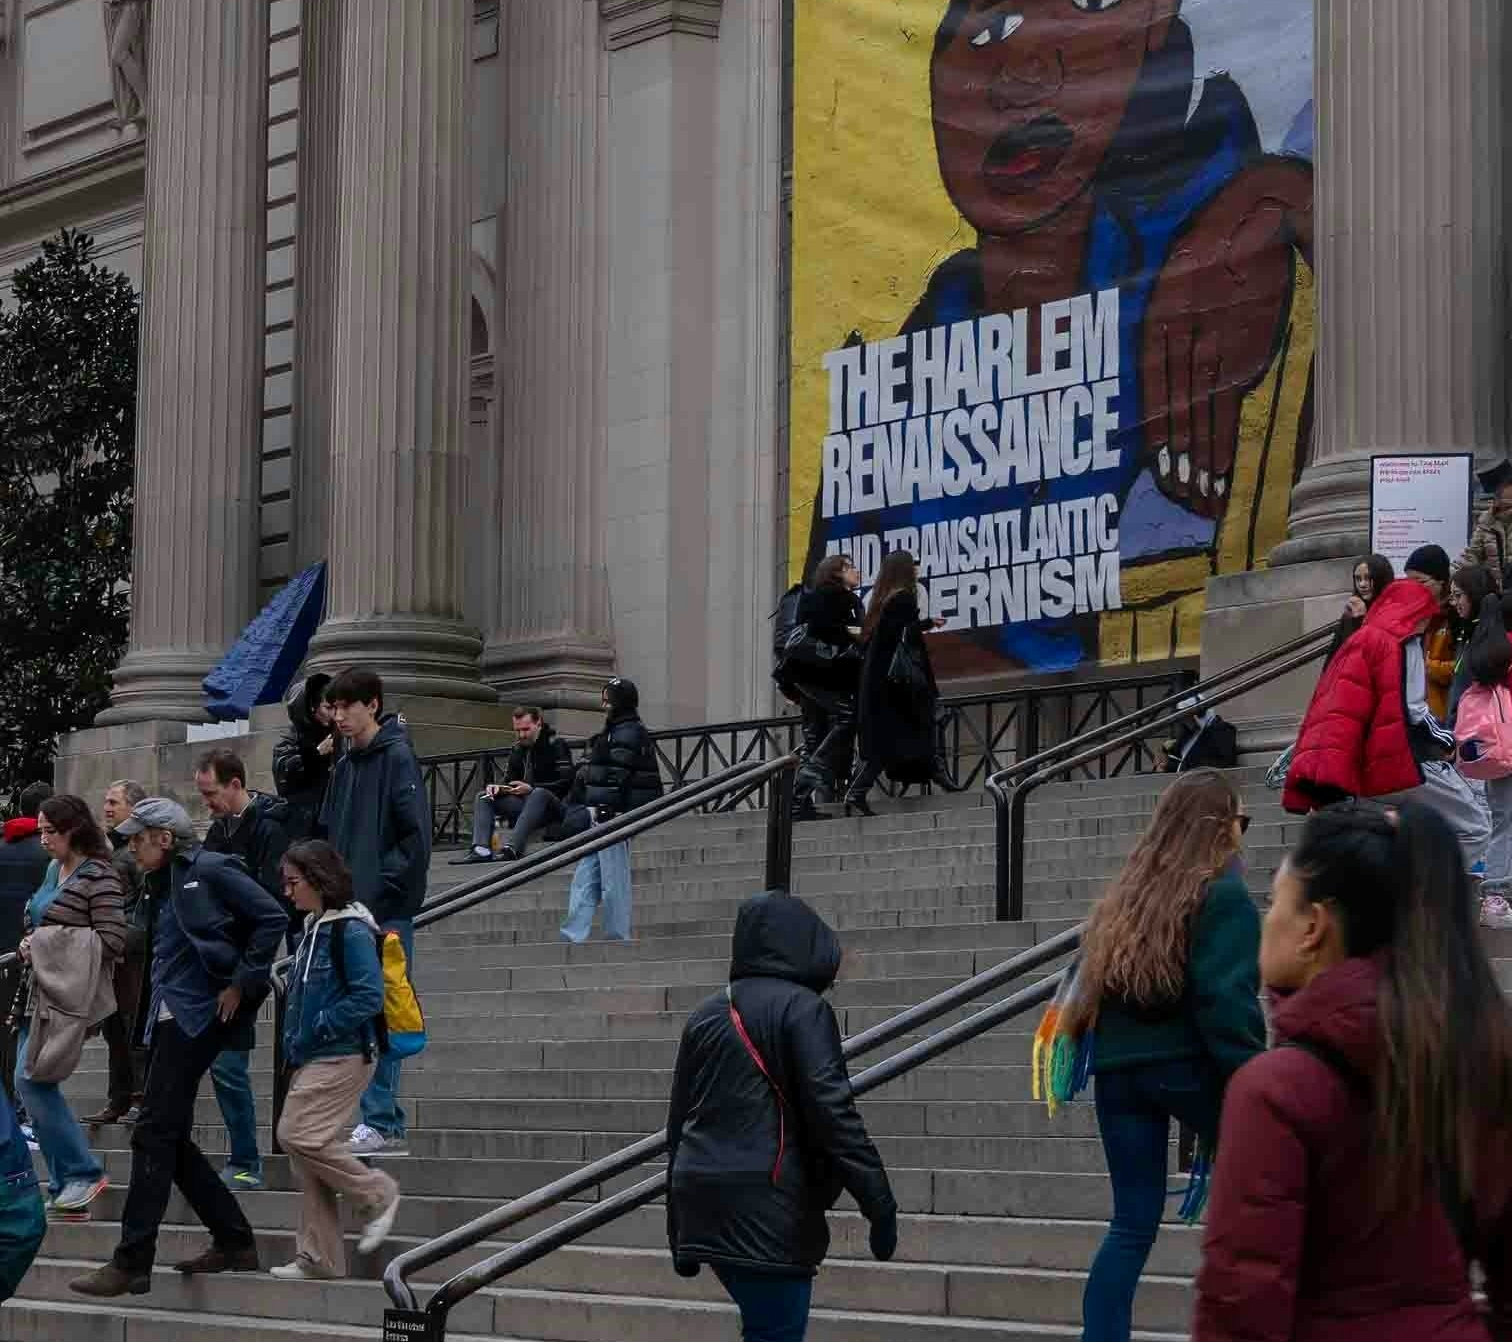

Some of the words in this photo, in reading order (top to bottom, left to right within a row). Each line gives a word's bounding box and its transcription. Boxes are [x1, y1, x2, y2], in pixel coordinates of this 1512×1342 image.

[823, 341, 910, 435] THE
[911, 288, 1121, 423] HARLEM
[823, 378, 1121, 518] RENAISSANCE
[881, 492, 1120, 576] TRANSATLANTIC
